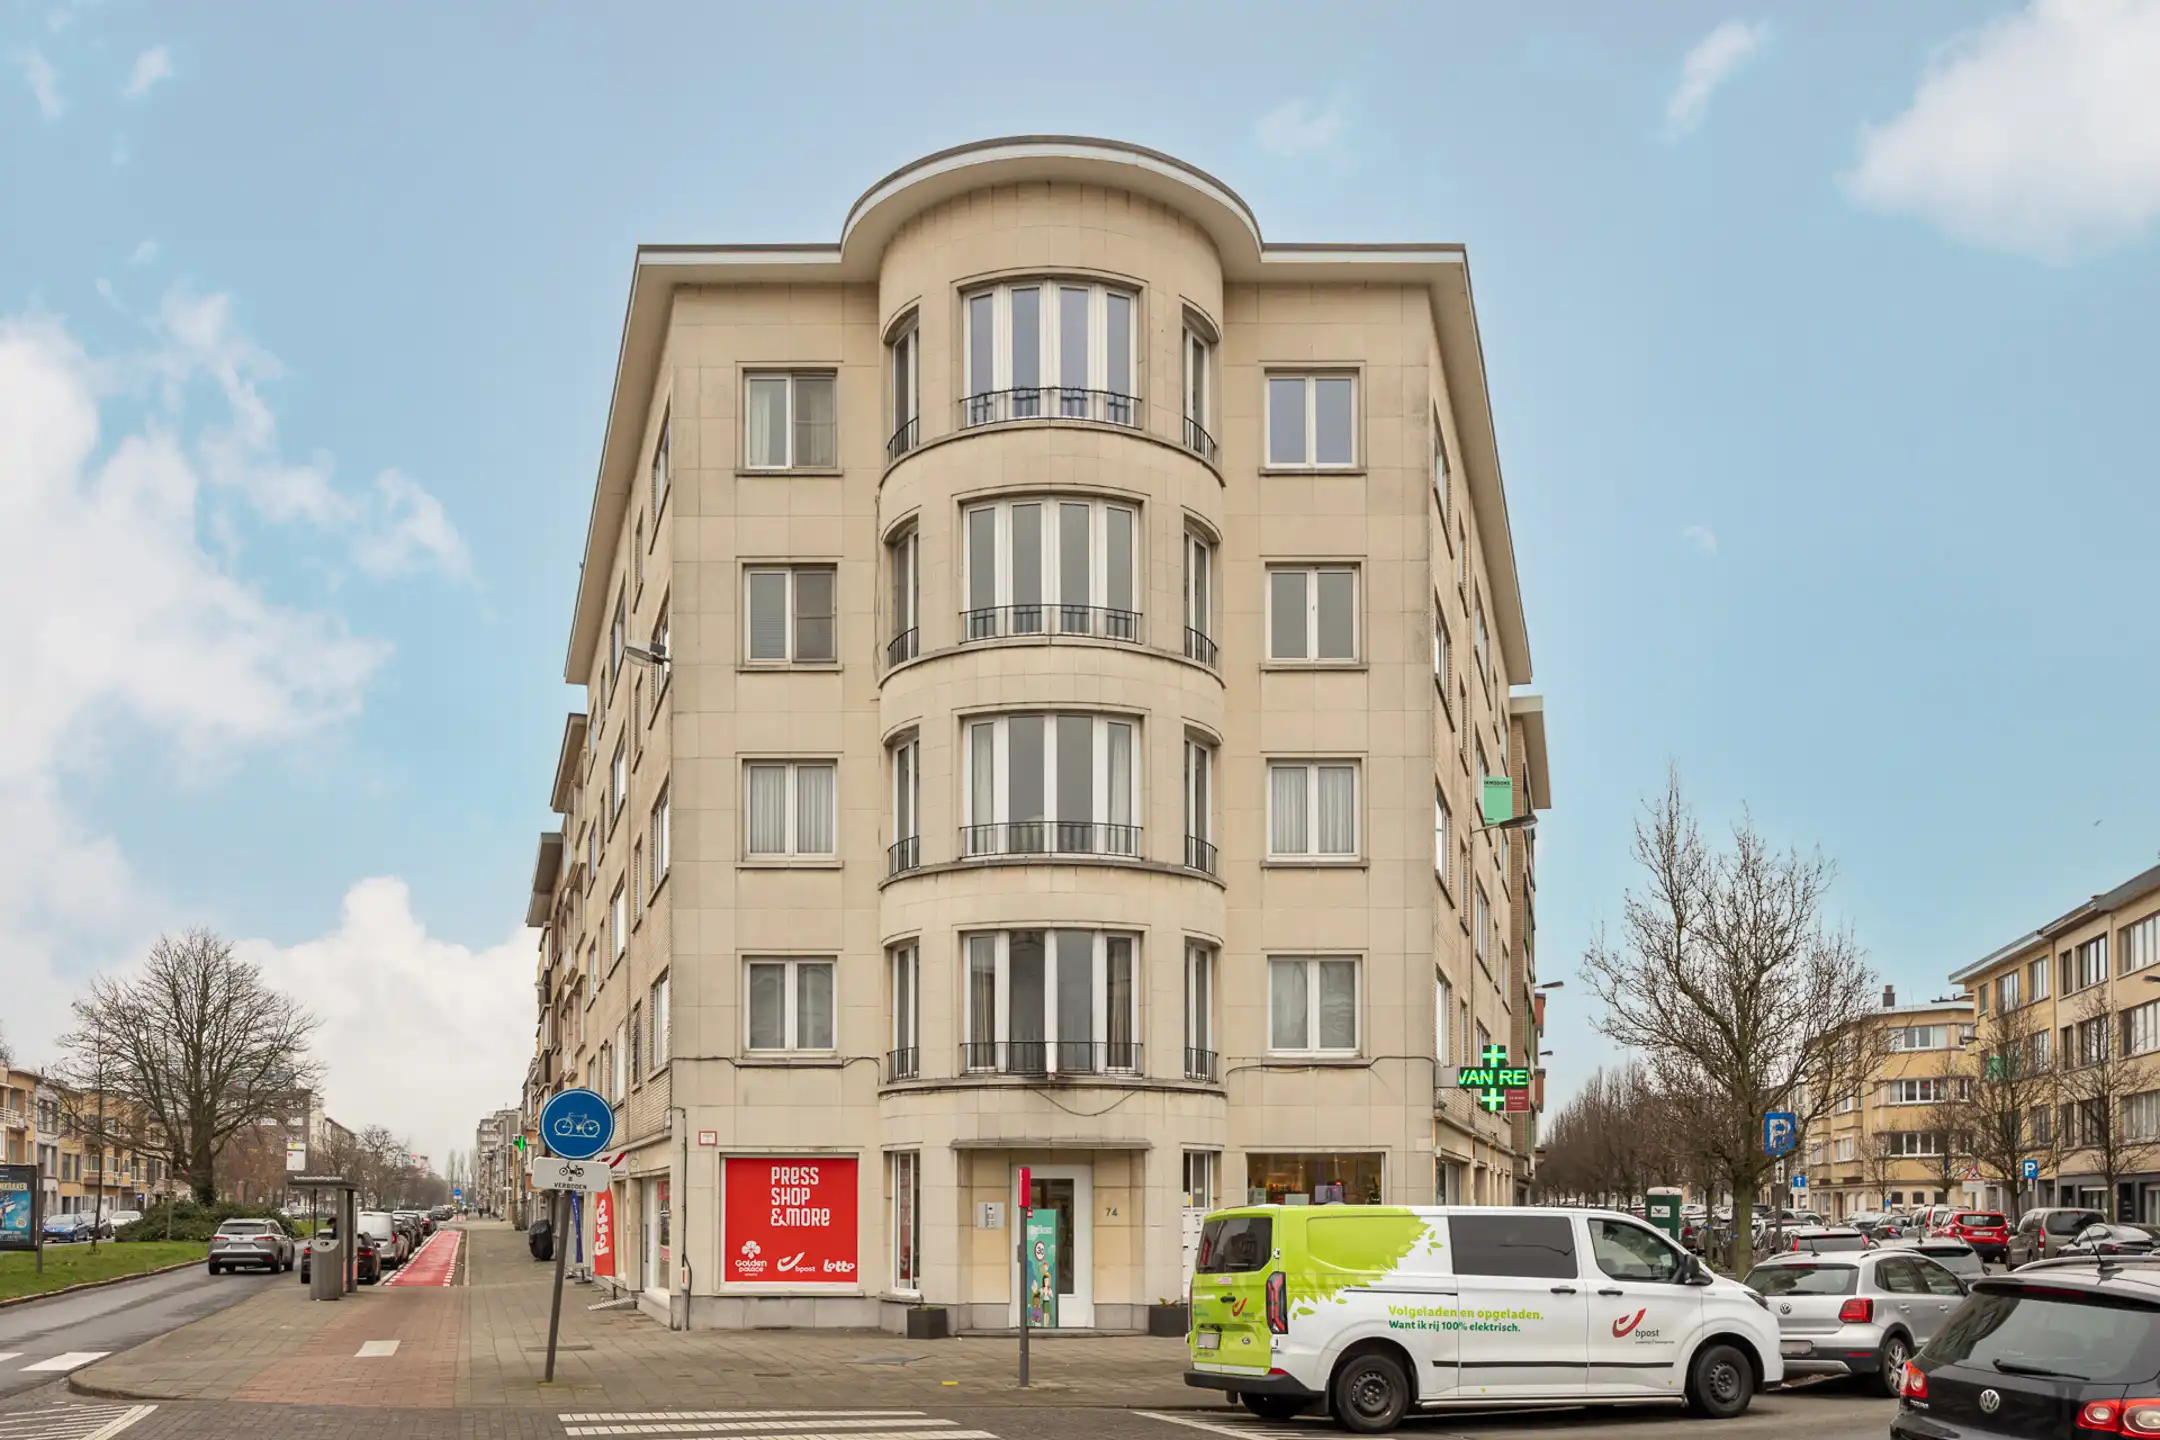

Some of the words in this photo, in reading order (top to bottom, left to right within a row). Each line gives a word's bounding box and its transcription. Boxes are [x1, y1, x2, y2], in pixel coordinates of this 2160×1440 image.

[2024, 1162, 2035, 1177] P
[554, 1182, 587, 1190] VERBODEN
[771, 1187, 811, 1206] SHOP
[1106, 1208, 1118, 1217] 74
[1388, 1305, 1457, 1319] Volgeladen
[1477, 1309, 1544, 1321] opgeladen.
[1389, 1320, 1415, 1329] Want
[1417, 1320, 1427, 1329] ik
[1428, 1321, 1440, 1332] rij
[1441, 1322, 1468, 1331] 100%
[1469, 1323, 1521, 1333] elektrisch.
[1635, 1329, 1660, 1339] bpost
